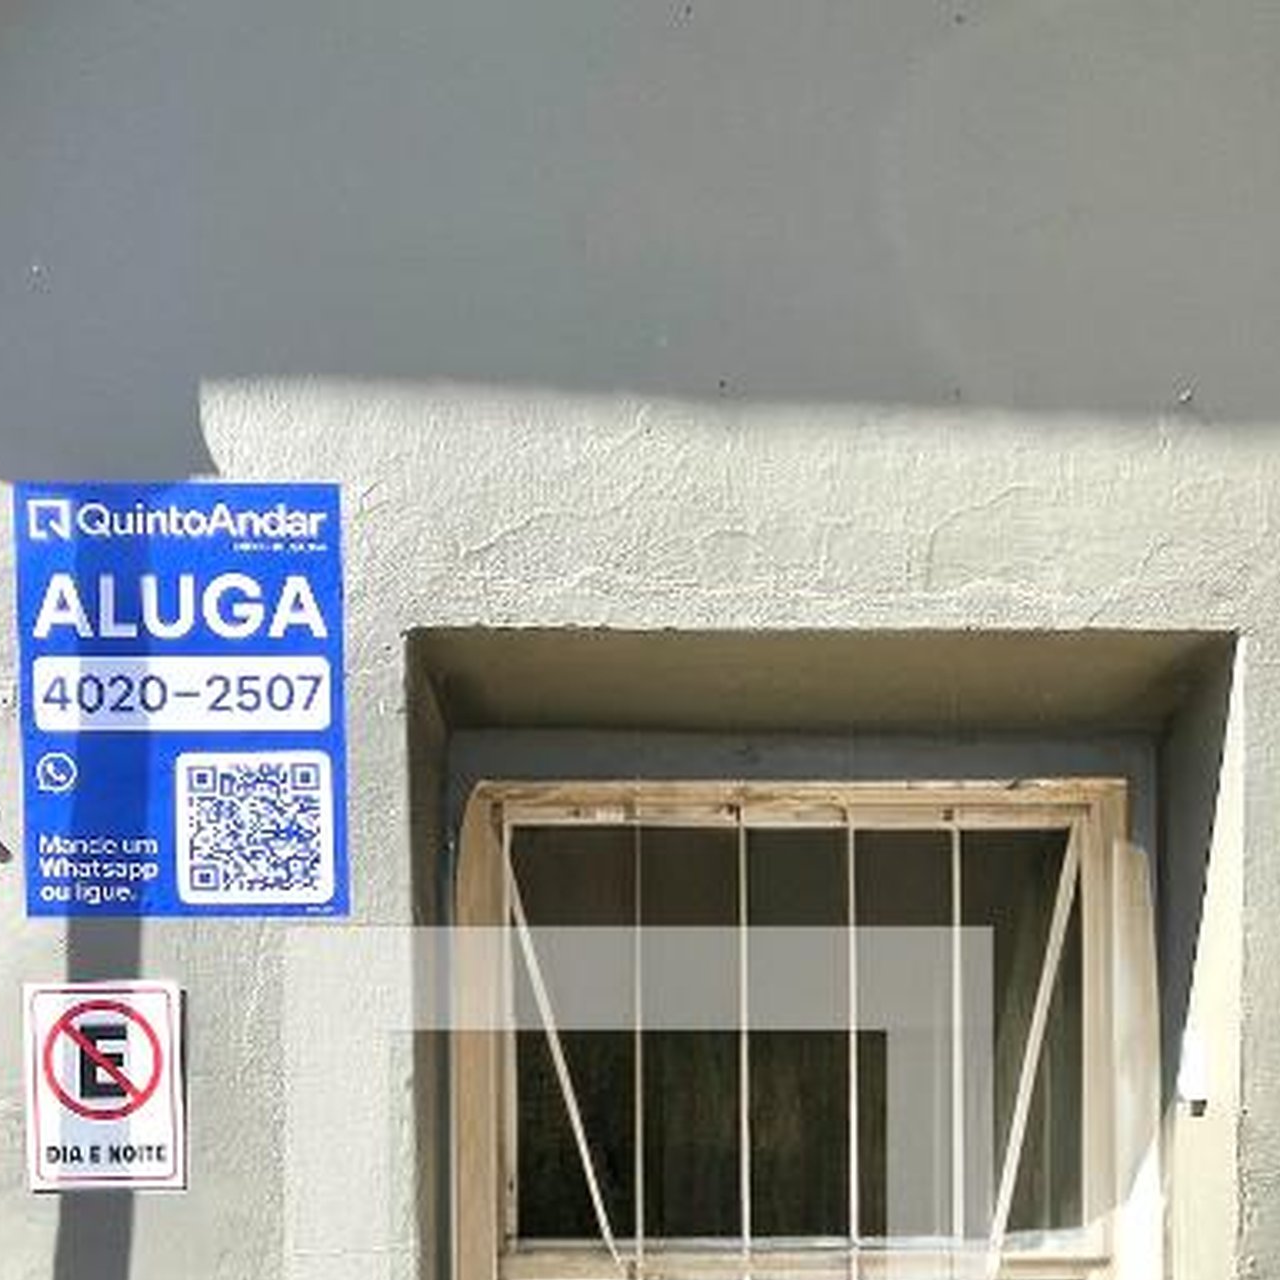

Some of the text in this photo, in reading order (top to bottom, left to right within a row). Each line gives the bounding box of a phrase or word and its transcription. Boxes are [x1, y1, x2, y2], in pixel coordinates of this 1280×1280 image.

[77, 502, 327, 538] QuintoAndar
[32, 572, 328, 638] ALUGA
[42, 675, 324, 713] 4020-2507
[39, 834, 158, 855] Mande um
[39, 857, 159, 881] Whatsapp
[40, 881, 136, 905] ou ligue.
[80, 1023, 127, 1098] E
[46, 1146, 167, 1164] DIA E NOITE
